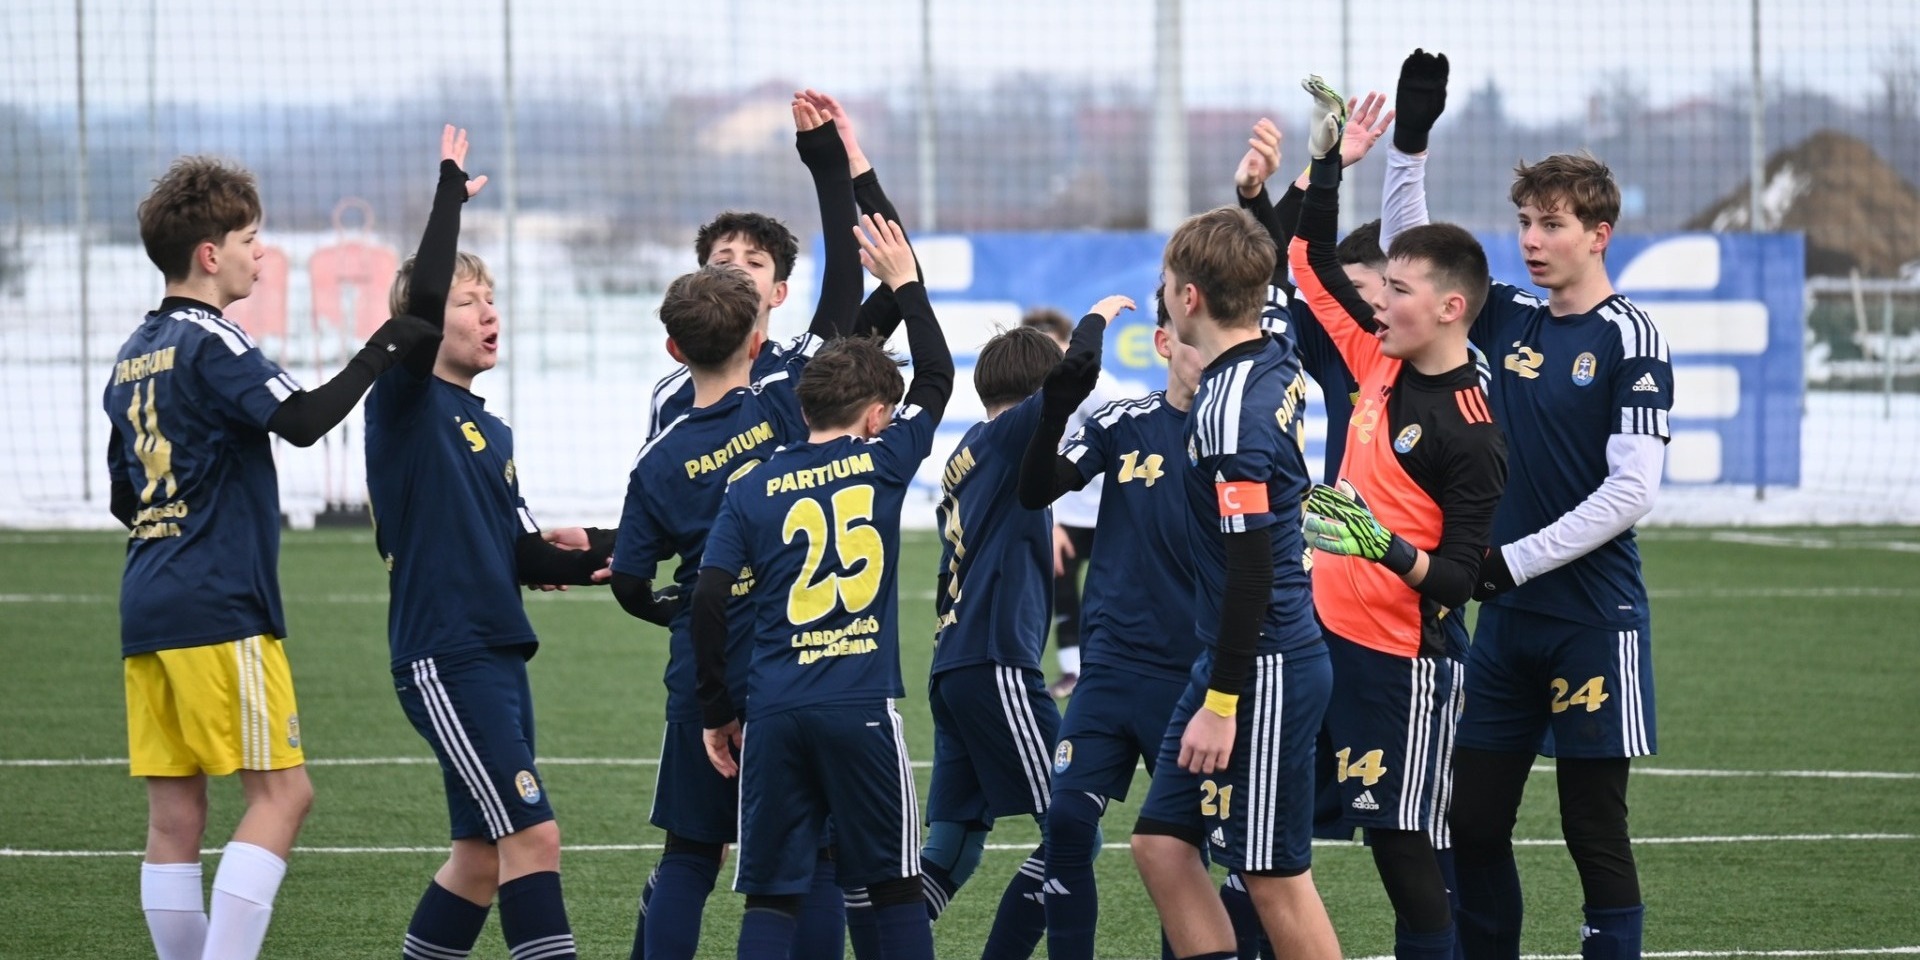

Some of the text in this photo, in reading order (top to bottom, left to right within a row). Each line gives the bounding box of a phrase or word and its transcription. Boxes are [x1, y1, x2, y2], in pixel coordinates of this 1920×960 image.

[685, 421, 774, 479] PARTIUM
[1118, 450, 1165, 488] 14
[766, 453, 875, 496] PARTIUM
[1223, 486, 1241, 510] C
[782, 484, 885, 626] 25
[1551, 676, 1609, 713] 24
[1335, 747, 1388, 786] 14
[1200, 780, 1233, 820] 21
